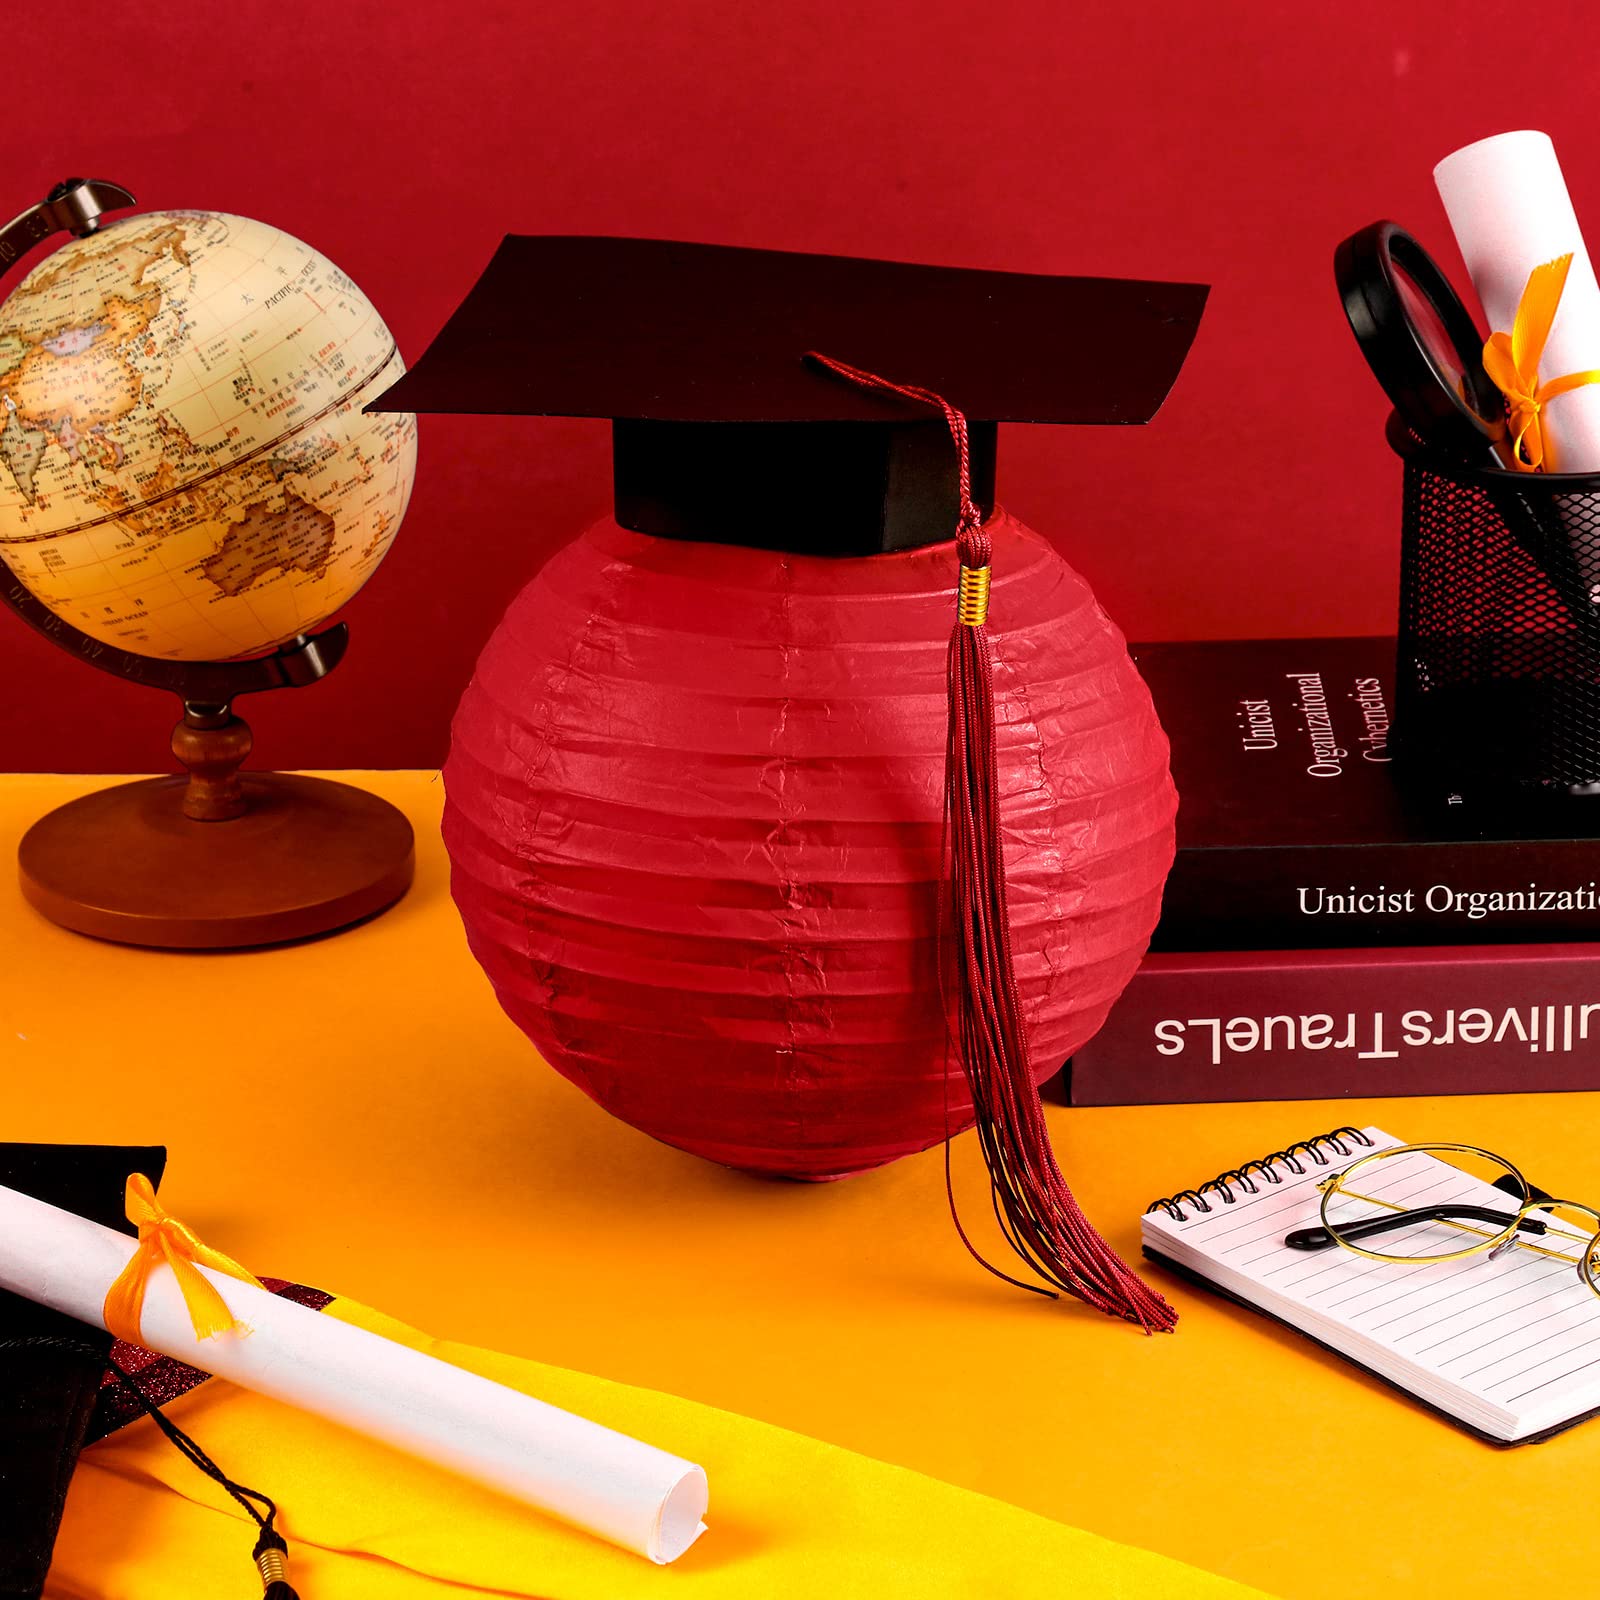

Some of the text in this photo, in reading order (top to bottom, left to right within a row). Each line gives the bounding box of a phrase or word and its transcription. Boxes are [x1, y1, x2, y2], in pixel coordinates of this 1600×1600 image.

[264, 283, 295, 309] PACIFIC
[1237, 699, 1278, 751] Unicist
[1286, 672, 1348, 778] Organizational
[1297, 881, 1600, 919] Unicist Organizati
